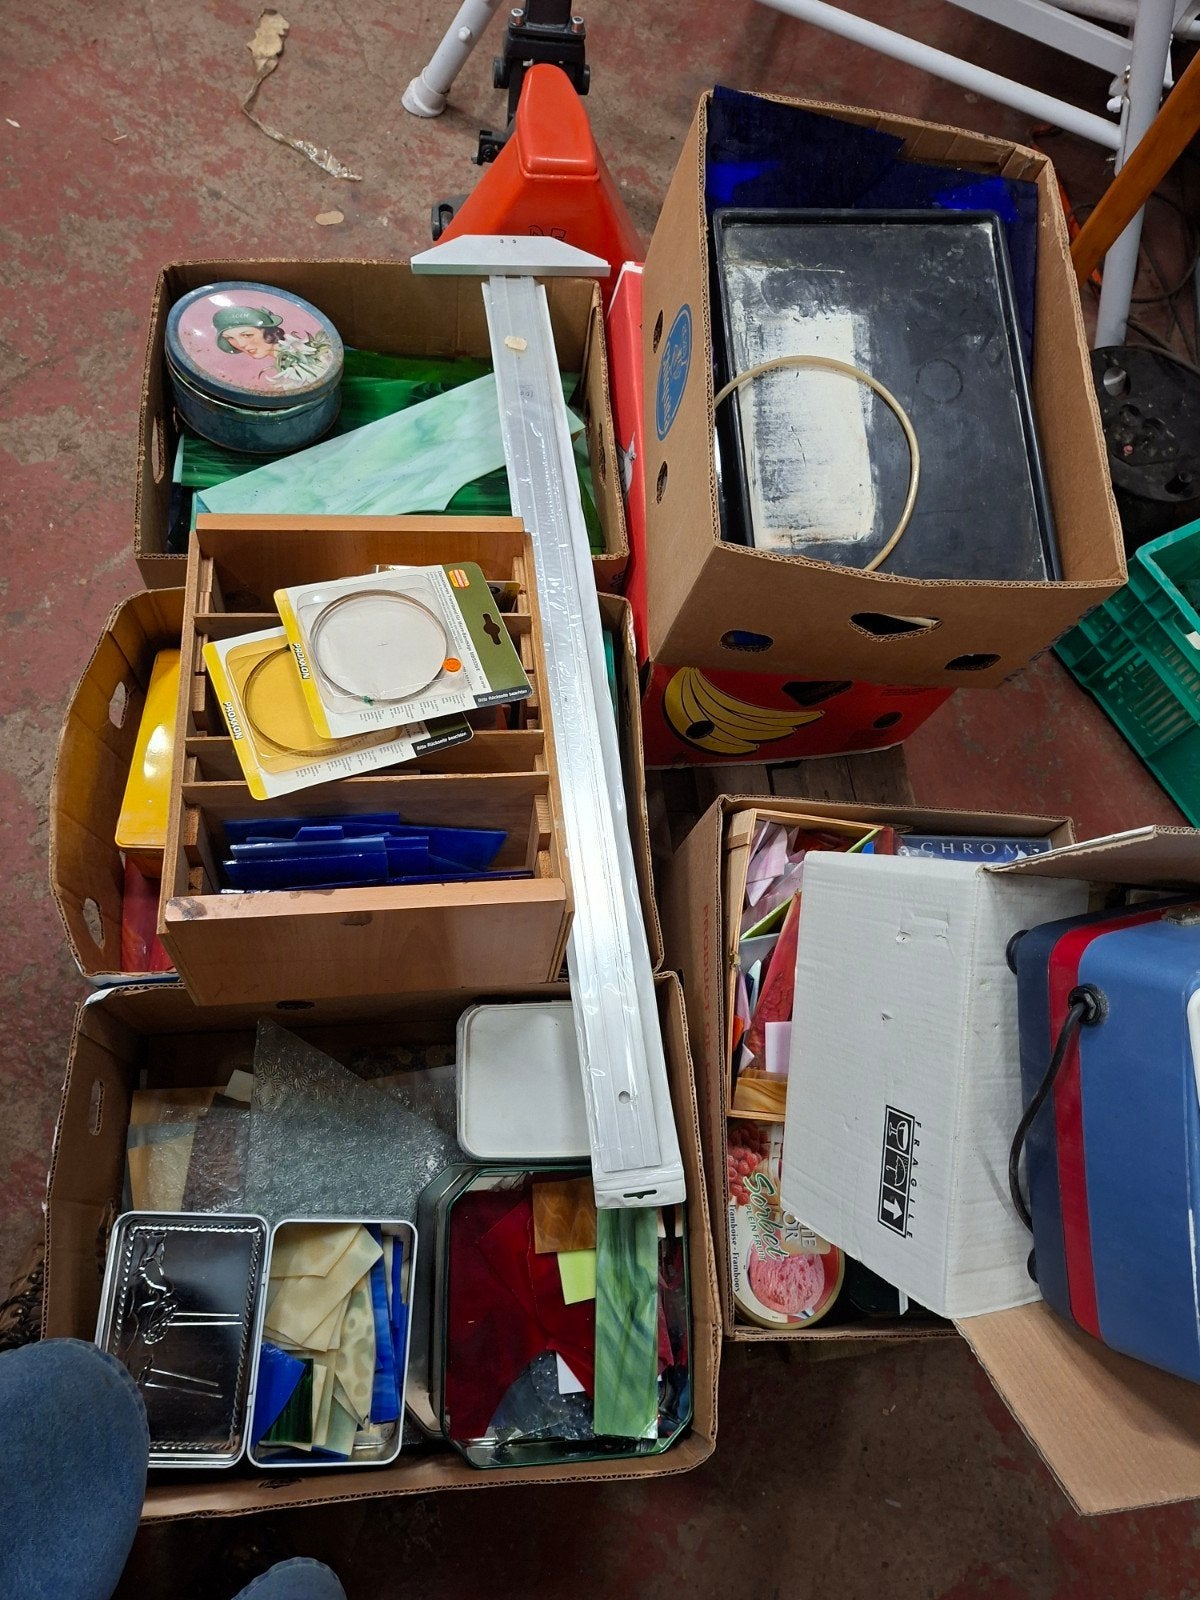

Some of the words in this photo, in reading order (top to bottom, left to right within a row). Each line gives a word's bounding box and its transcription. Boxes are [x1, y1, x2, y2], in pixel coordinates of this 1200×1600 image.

[293, 643, 310, 680] PROXXON
[223, 701, 243, 740] PROXXON
[704, 1022, 711, 1052] OF
[906, 1121, 922, 1238] FRAGILE
[729, 1204, 739, 1245] Framboise
[743, 1172, 790, 1261] Sorbet
[745, 1205, 758, 1232] PLEIN
[752, 1234, 767, 1262] FRUIT
[732, 1252, 740, 1293] Framboos
